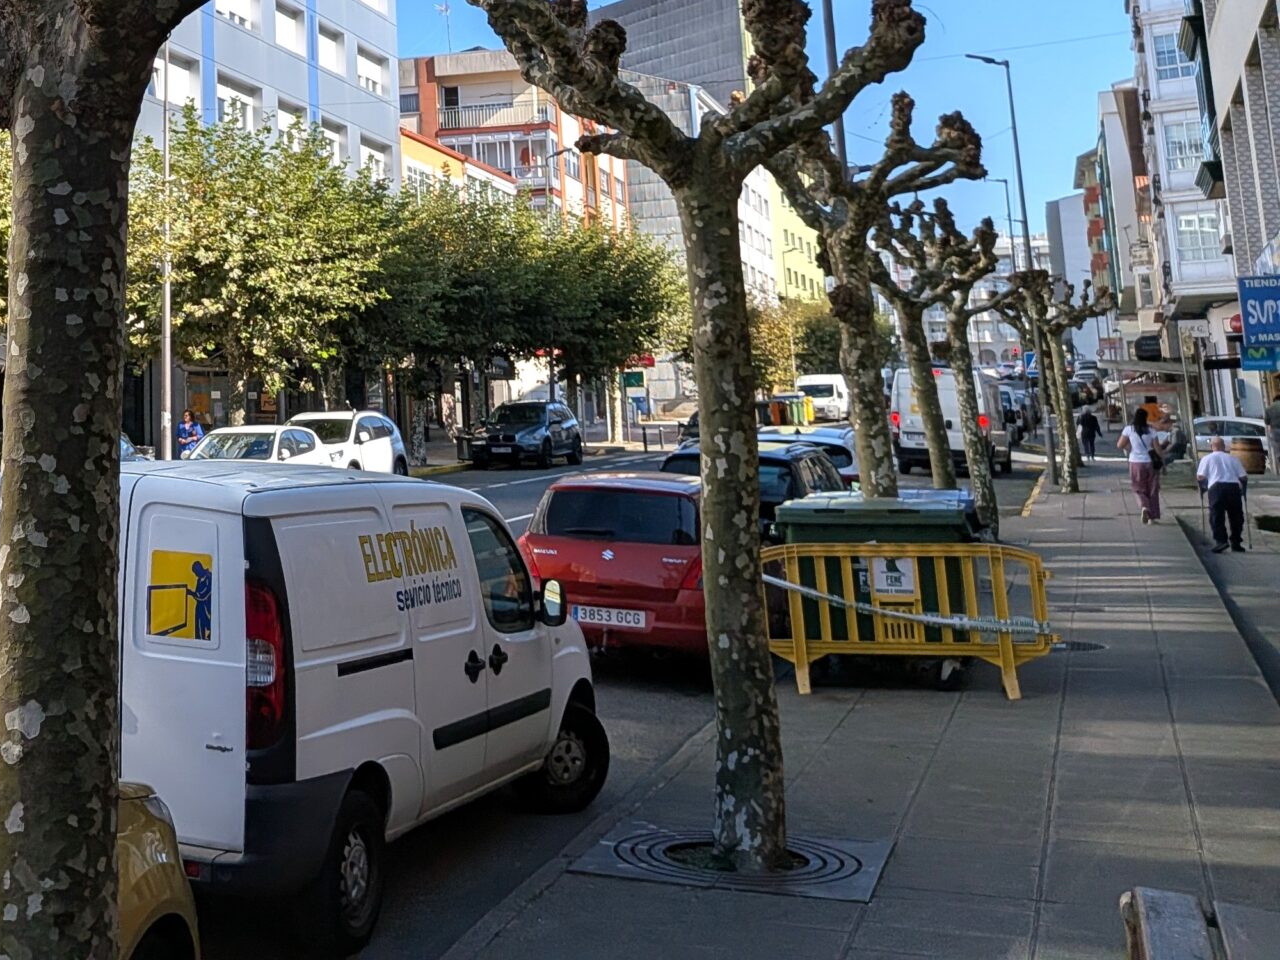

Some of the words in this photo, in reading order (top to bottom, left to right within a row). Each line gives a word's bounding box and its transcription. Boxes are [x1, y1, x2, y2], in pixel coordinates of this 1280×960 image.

[358, 519, 457, 583] ELECTRÓNICA
[432, 573, 462, 604] técnico
[580, 607, 612, 623] 3853
[616, 611, 641, 625] GCG
